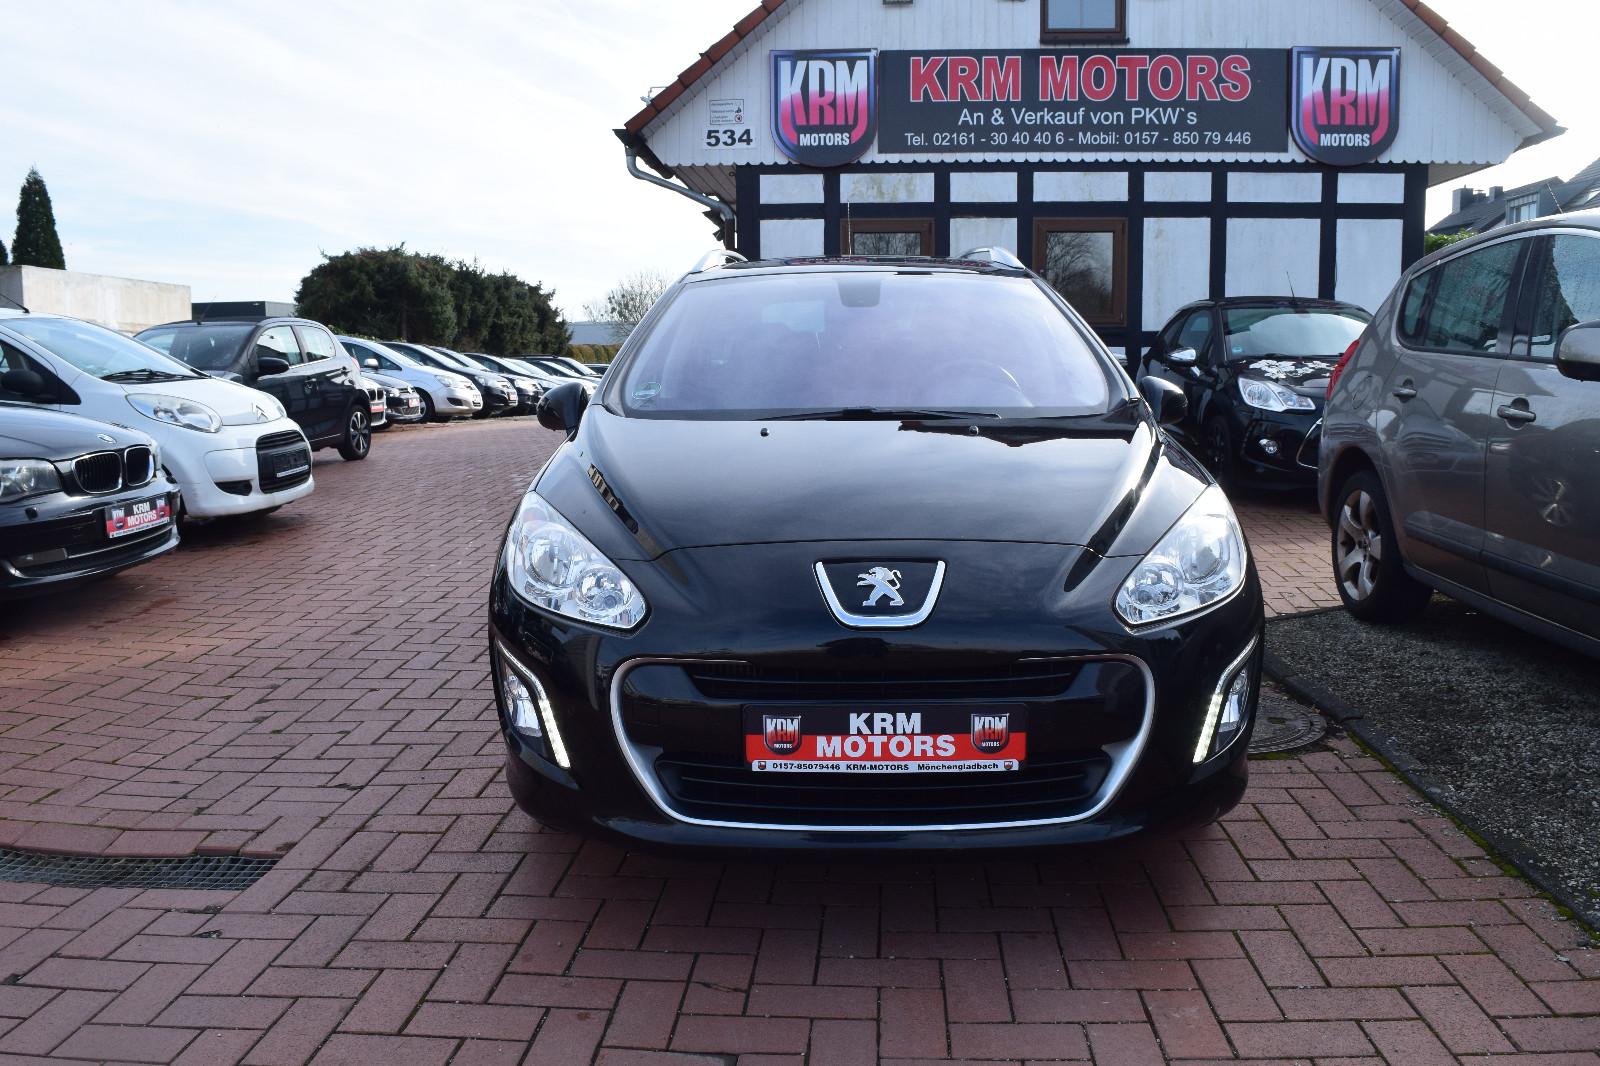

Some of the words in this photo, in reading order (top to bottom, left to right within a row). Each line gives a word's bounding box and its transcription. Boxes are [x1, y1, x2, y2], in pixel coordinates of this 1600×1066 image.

[910, 55, 1022, 103] KRM
[1038, 54, 1252, 103] MOTORS
[779, 59, 868, 129] KRM
[1301, 58, 1390, 129] KRM
[958, 108, 985, 126] An
[991, 109, 1005, 126] &
[1011, 107, 1085, 126] Verkauf
[1090, 111, 1124, 125] von
[706, 128, 753, 148] 534
[799, 132, 850, 147] MOTORS
[904, 131, 928, 146] Tel.
[933, 131, 976, 146] 02161
[990, 131, 1008, 146] 30
[1011, 131, 1030, 146] 40
[1033, 131, 1052, 146] 40
[1055, 131, 1065, 145] 6
[1078, 130, 1120, 145] Mobil:
[1123, 131, 1159, 145] 0157
[1172, 131, 1199, 145] 850
[1203, 131, 1221, 145] 79
[1225, 131, 1251, 145] 446
[1320, 133, 1370, 147] MOTORS
[132, 502, 150, 514] KRM
[127, 510, 157, 527] MOTORS
[766, 718, 799, 742] KRM
[849, 712, 922, 735] KRM
[974, 716, 1007, 741] KRM
[816, 735, 956, 758] MOTORS
[846, 763, 909, 771] KRM-MOTORS
[917, 762, 999, 771] Mönchengladbach
